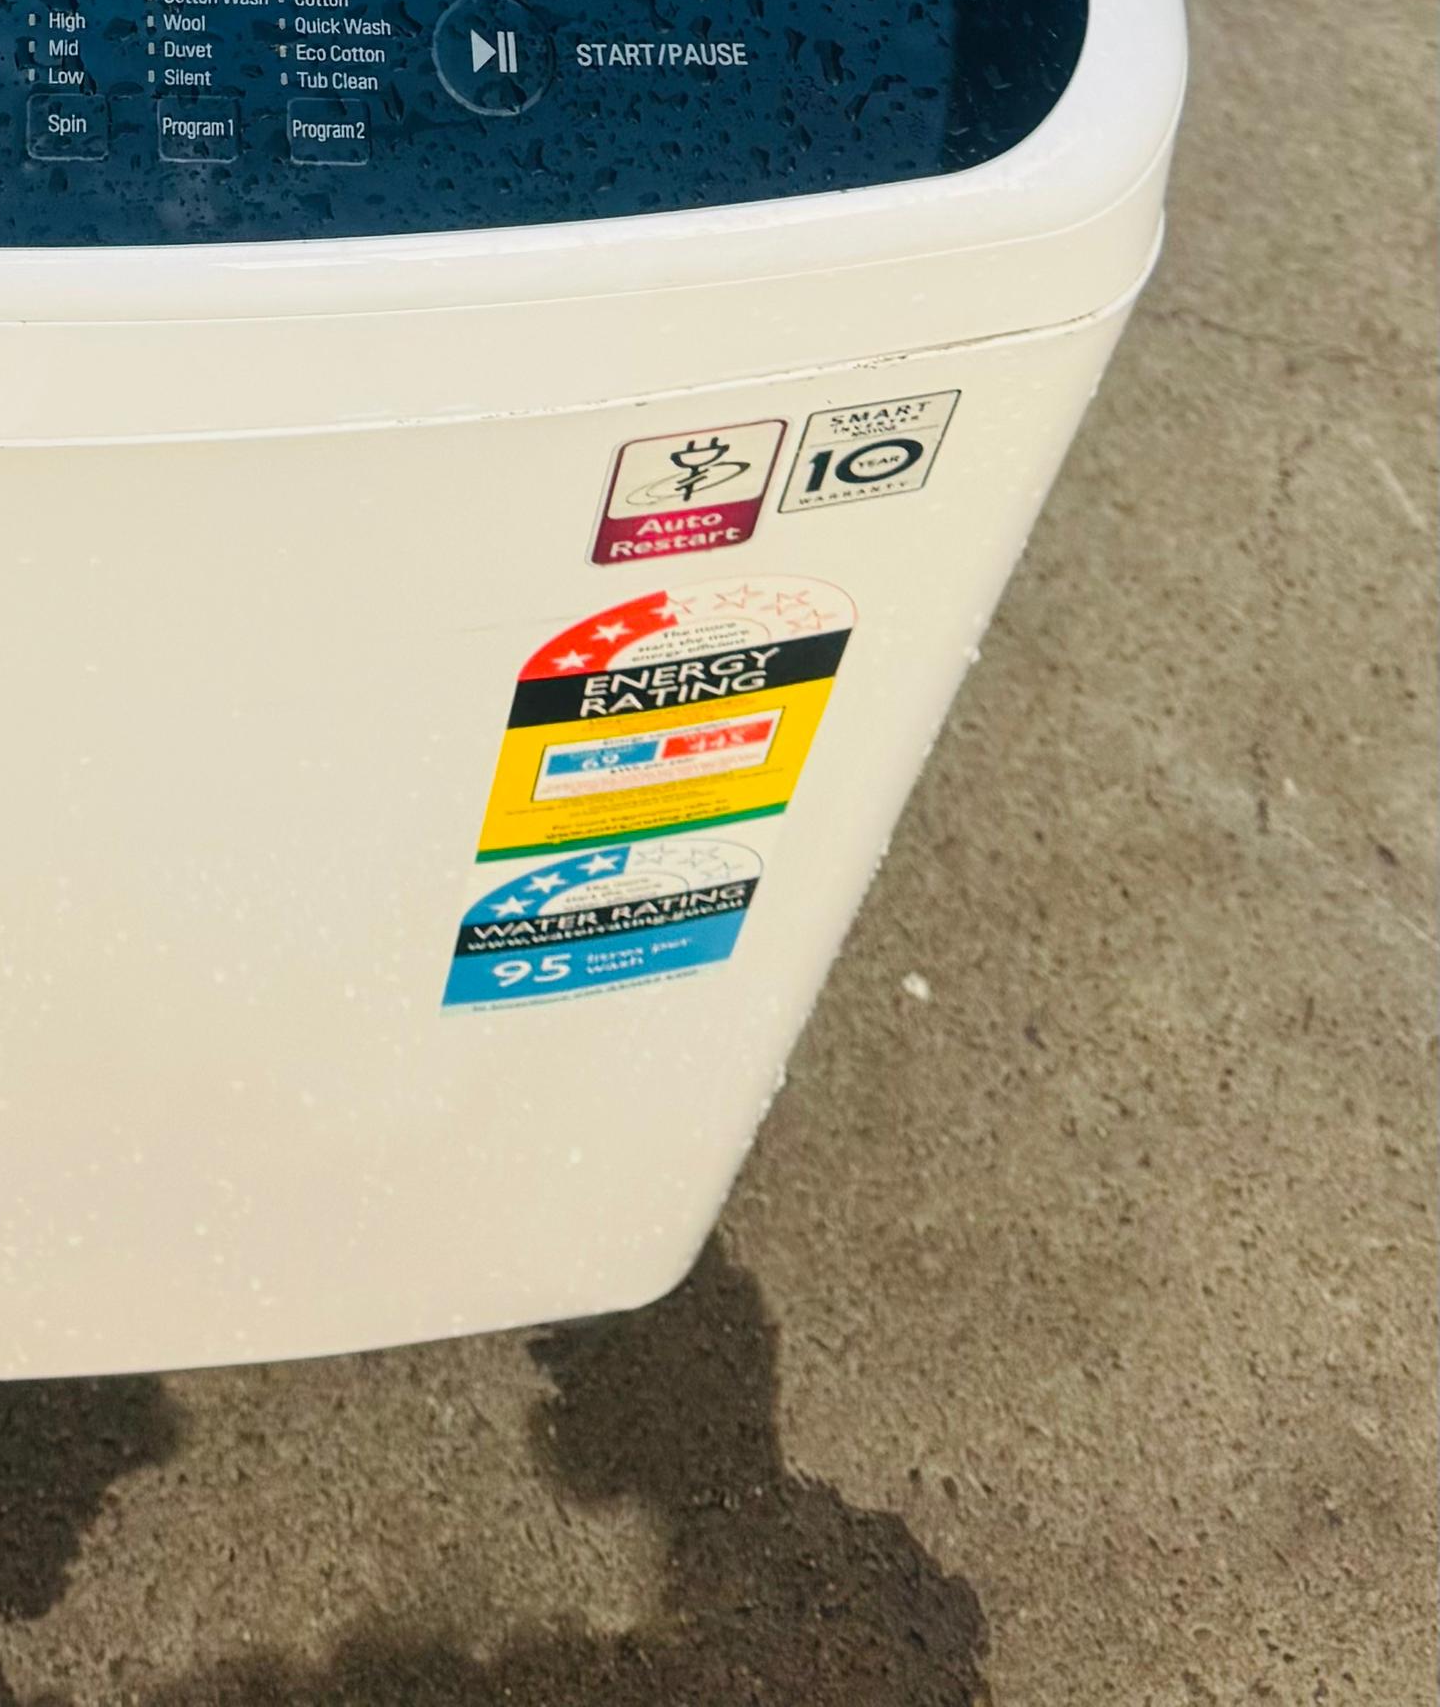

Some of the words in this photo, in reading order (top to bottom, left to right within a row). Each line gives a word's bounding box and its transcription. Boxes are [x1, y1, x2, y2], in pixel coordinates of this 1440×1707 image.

[48, 12, 86, 32] High
[163, 15, 206, 32] Wool
[295, 17, 340, 34] Quick
[343, 18, 391, 36] Wash
[48, 40, 79, 57] Mid
[164, 41, 213, 59] Duvet
[296, 44, 327, 62] Eco
[330, 45, 385, 63] Cotton
[576, 43, 748, 67] START/PAUSE
[48, 67, 84, 85] Low
[164, 69, 212, 86] Silent
[296, 72, 328, 89] Tub
[332, 72, 378, 90] Clean
[48, 114, 87, 135] Spin
[830, 401, 931, 424] SMART
[858, 455, 901, 469] YEAR
[636, 513, 723, 536] Auto
[610, 527, 741, 557] Restart
[585, 647, 781, 697] ENERGY
[579, 670, 768, 717] RATING
[473, 910, 598, 940] WATER
[612, 884, 746, 920] RATING
[492, 953, 572, 988] 95
